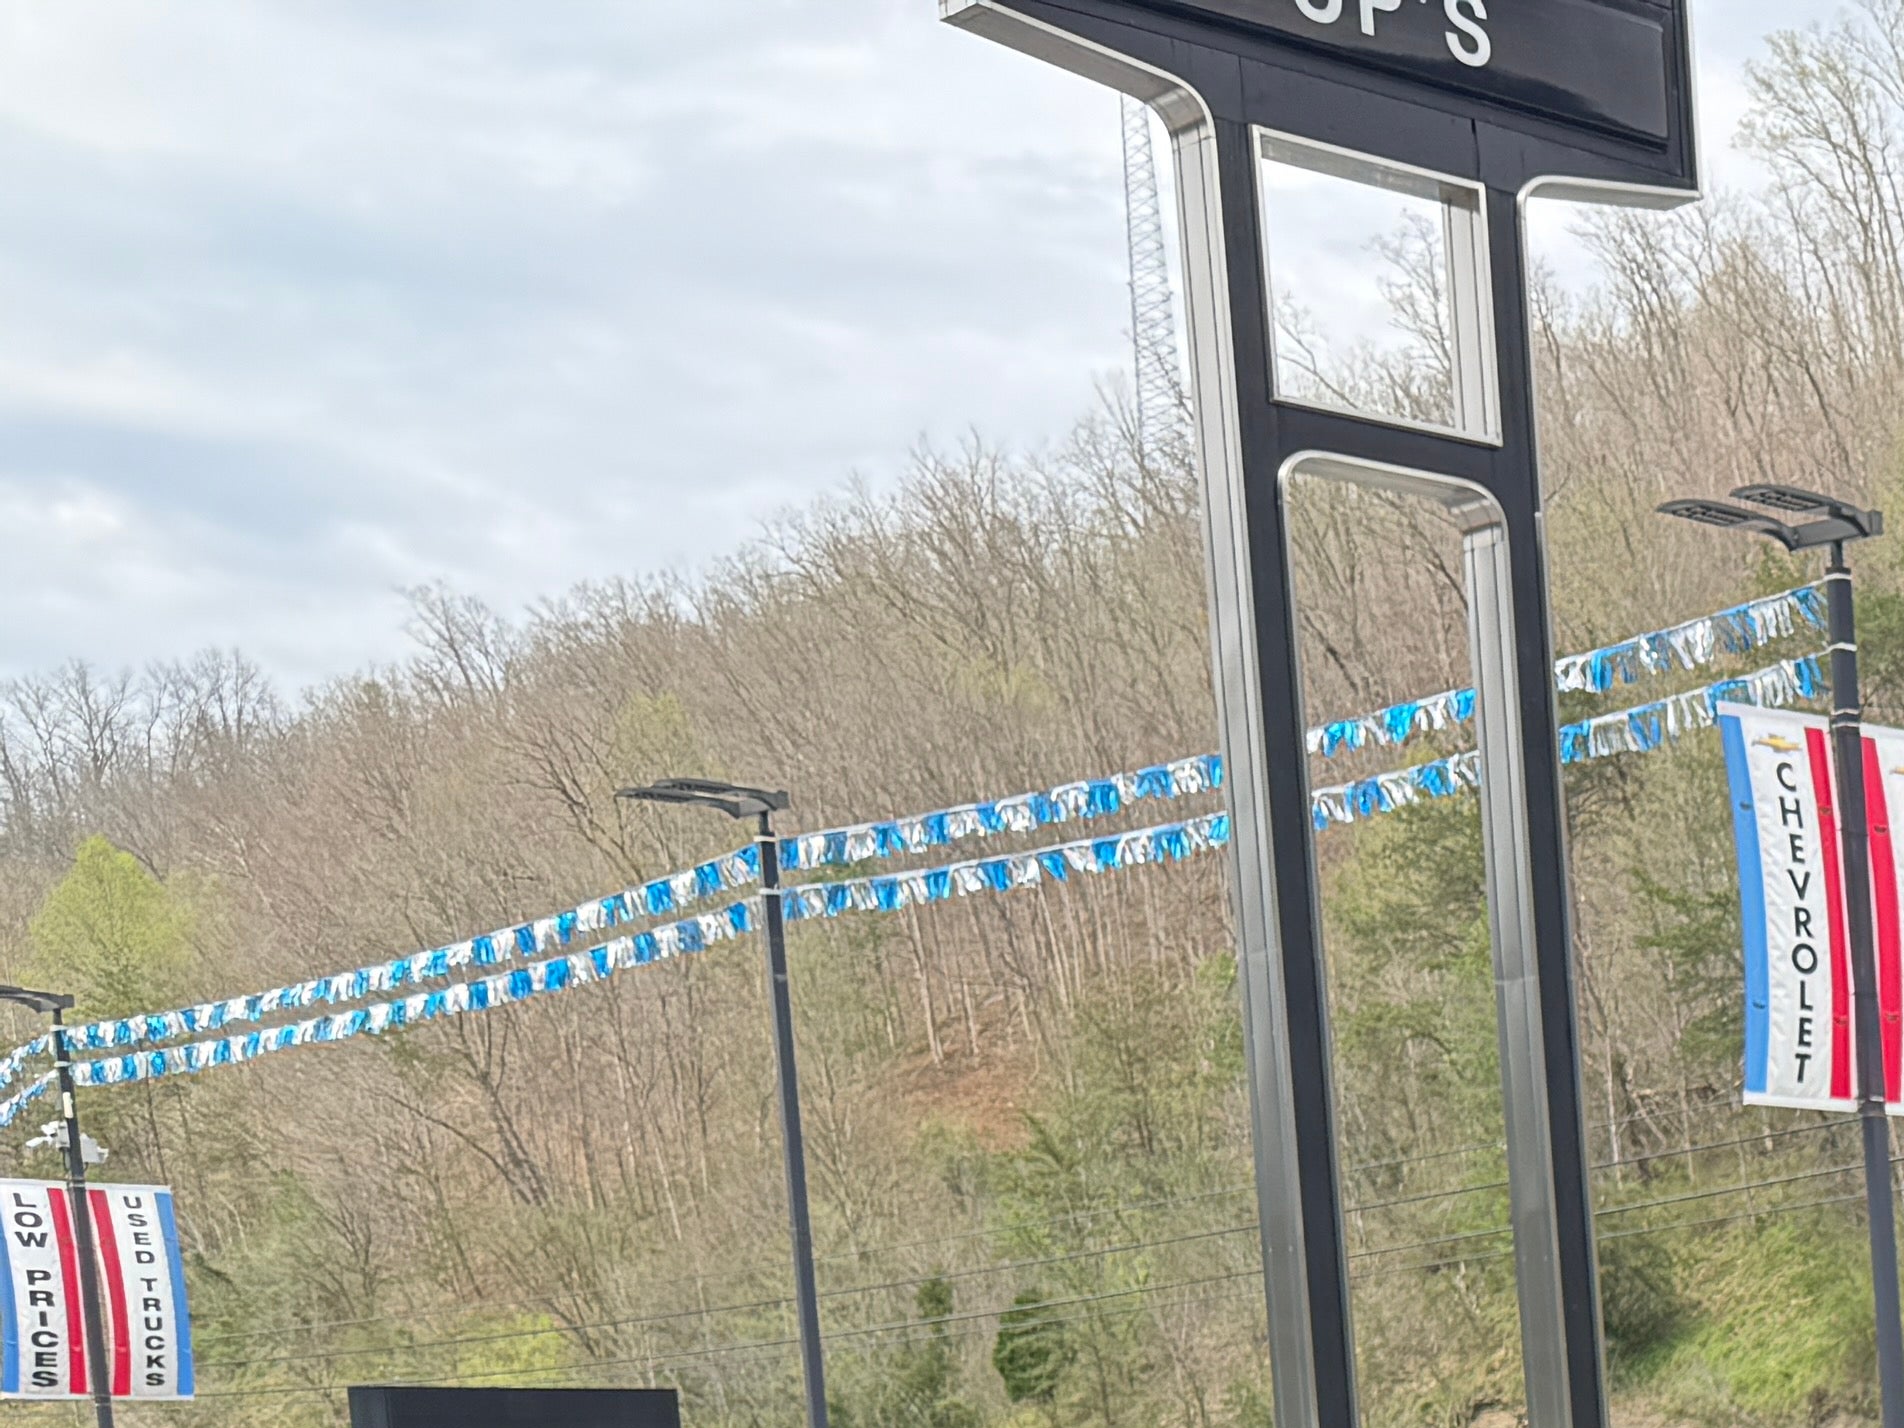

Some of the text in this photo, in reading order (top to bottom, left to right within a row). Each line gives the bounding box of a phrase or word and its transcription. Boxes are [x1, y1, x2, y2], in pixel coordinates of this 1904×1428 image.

[1776, 761, 1819, 1083] CHEVROLET
[13, 1192, 59, 1388] LOW PRICES
[123, 1195, 167, 1387] USED TRUCKS
